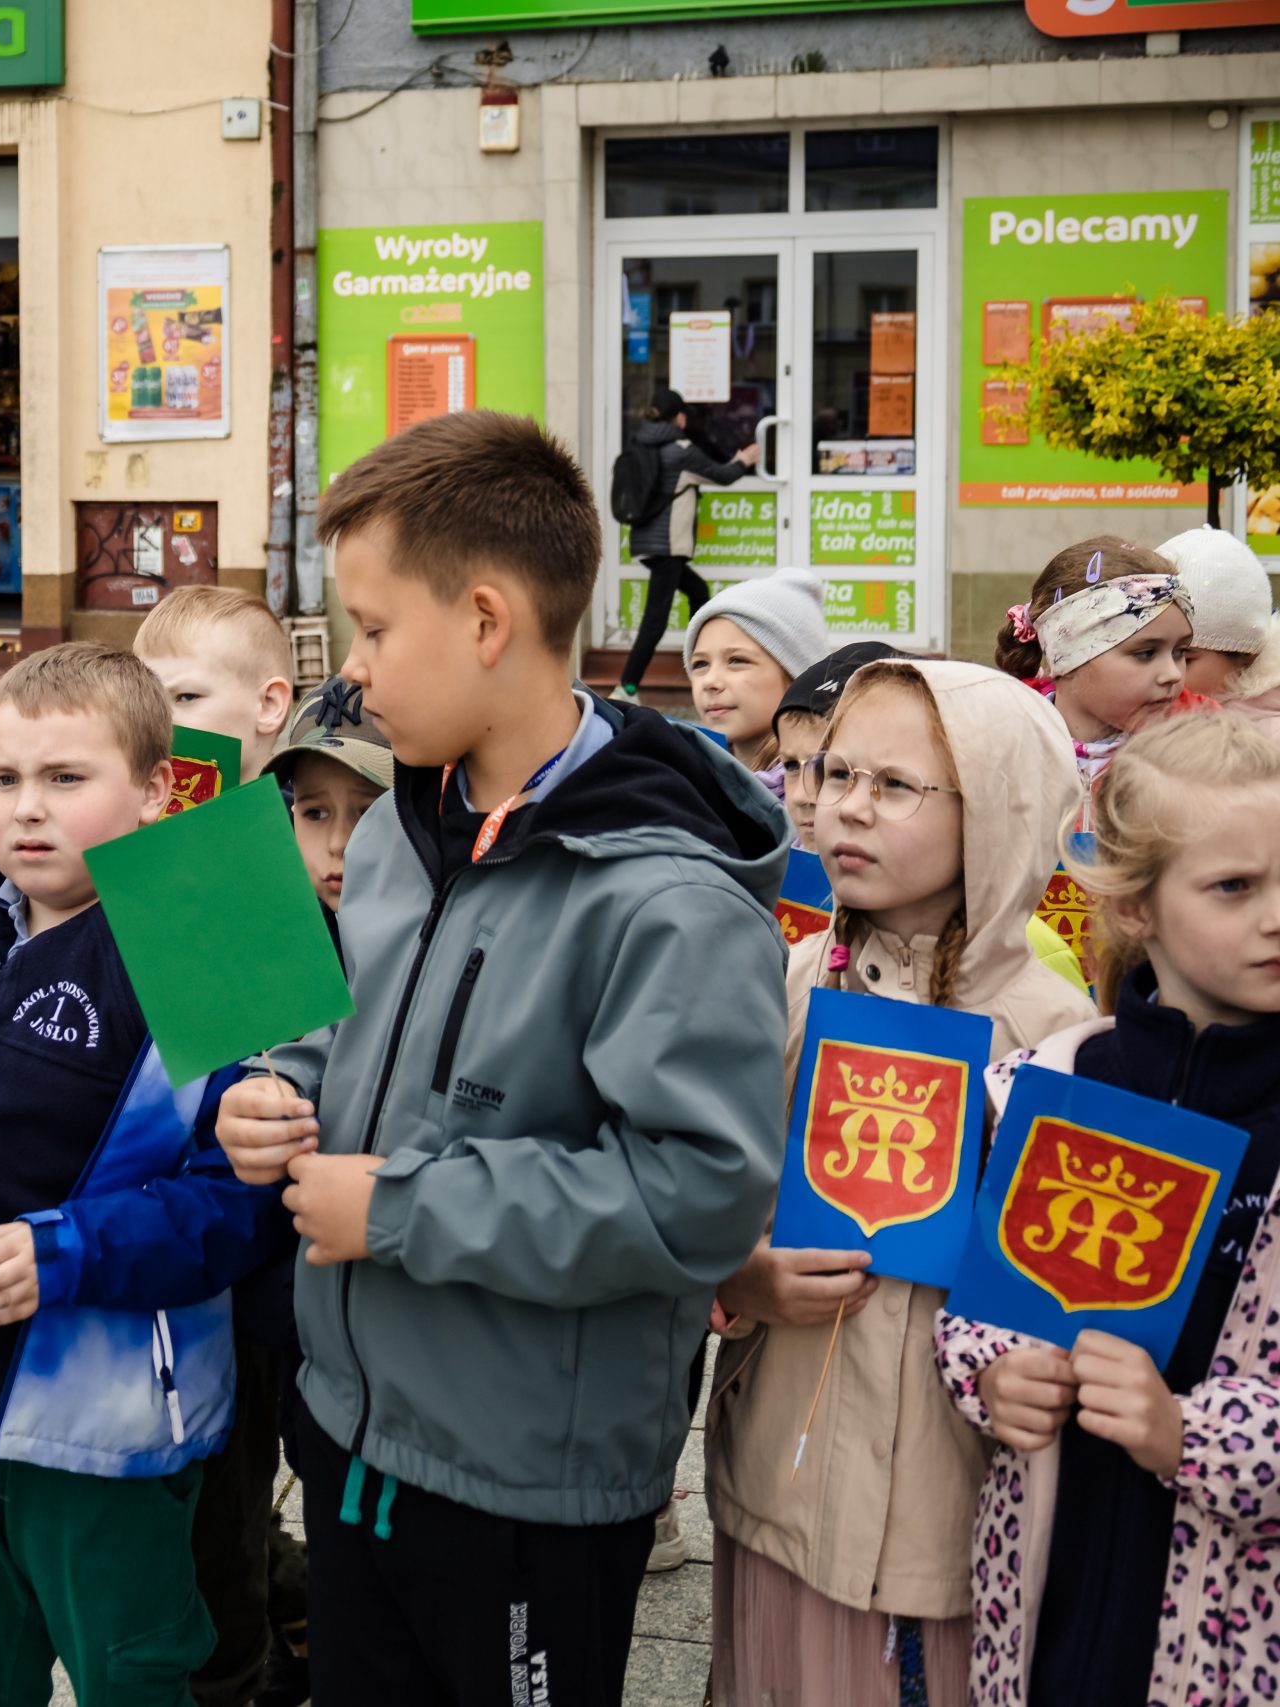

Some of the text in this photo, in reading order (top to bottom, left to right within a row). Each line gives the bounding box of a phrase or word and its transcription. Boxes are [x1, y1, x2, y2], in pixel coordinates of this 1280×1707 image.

[989, 209, 1199, 249] Polecamy
[374, 232, 489, 266] Wyroby
[331, 264, 533, 299] Garmażeryjne
[710, 497, 753, 520] tak
[820, 533, 857, 552] tak
[49, 995, 66, 1023] 1
